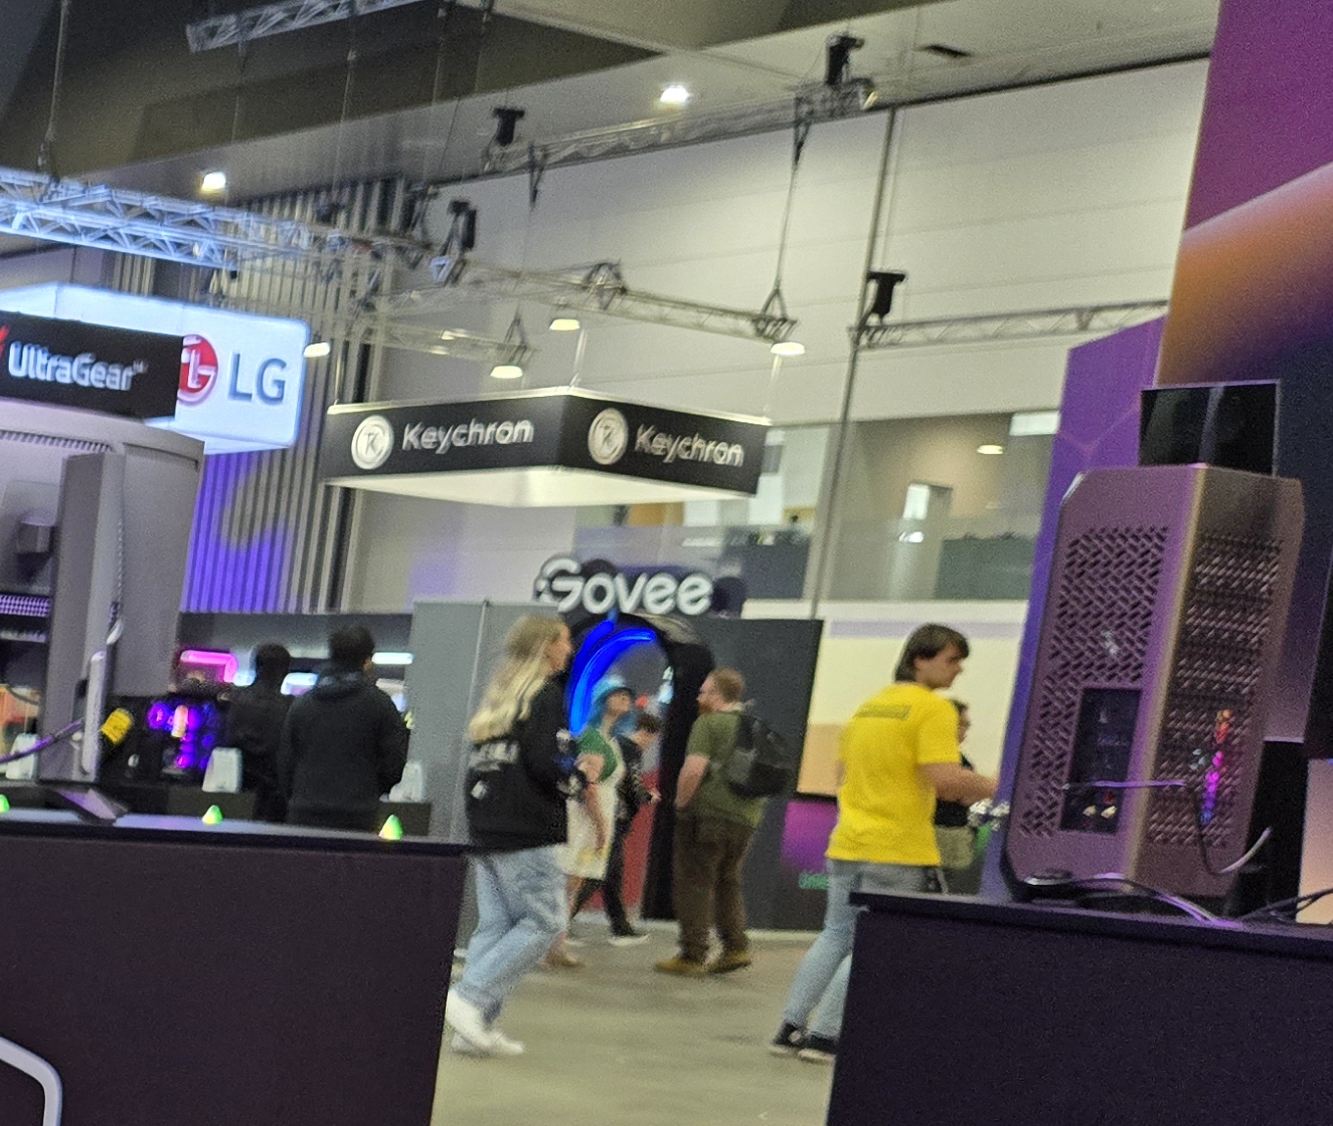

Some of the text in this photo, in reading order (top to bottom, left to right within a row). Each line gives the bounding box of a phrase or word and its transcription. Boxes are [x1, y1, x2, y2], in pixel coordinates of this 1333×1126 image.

[8, 341, 132, 391] UltraGear
[230, 352, 287, 404] LG
[401, 418, 533, 455] Keychron
[634, 424, 744, 467] Keychron
[536, 557, 713, 615] Govee
